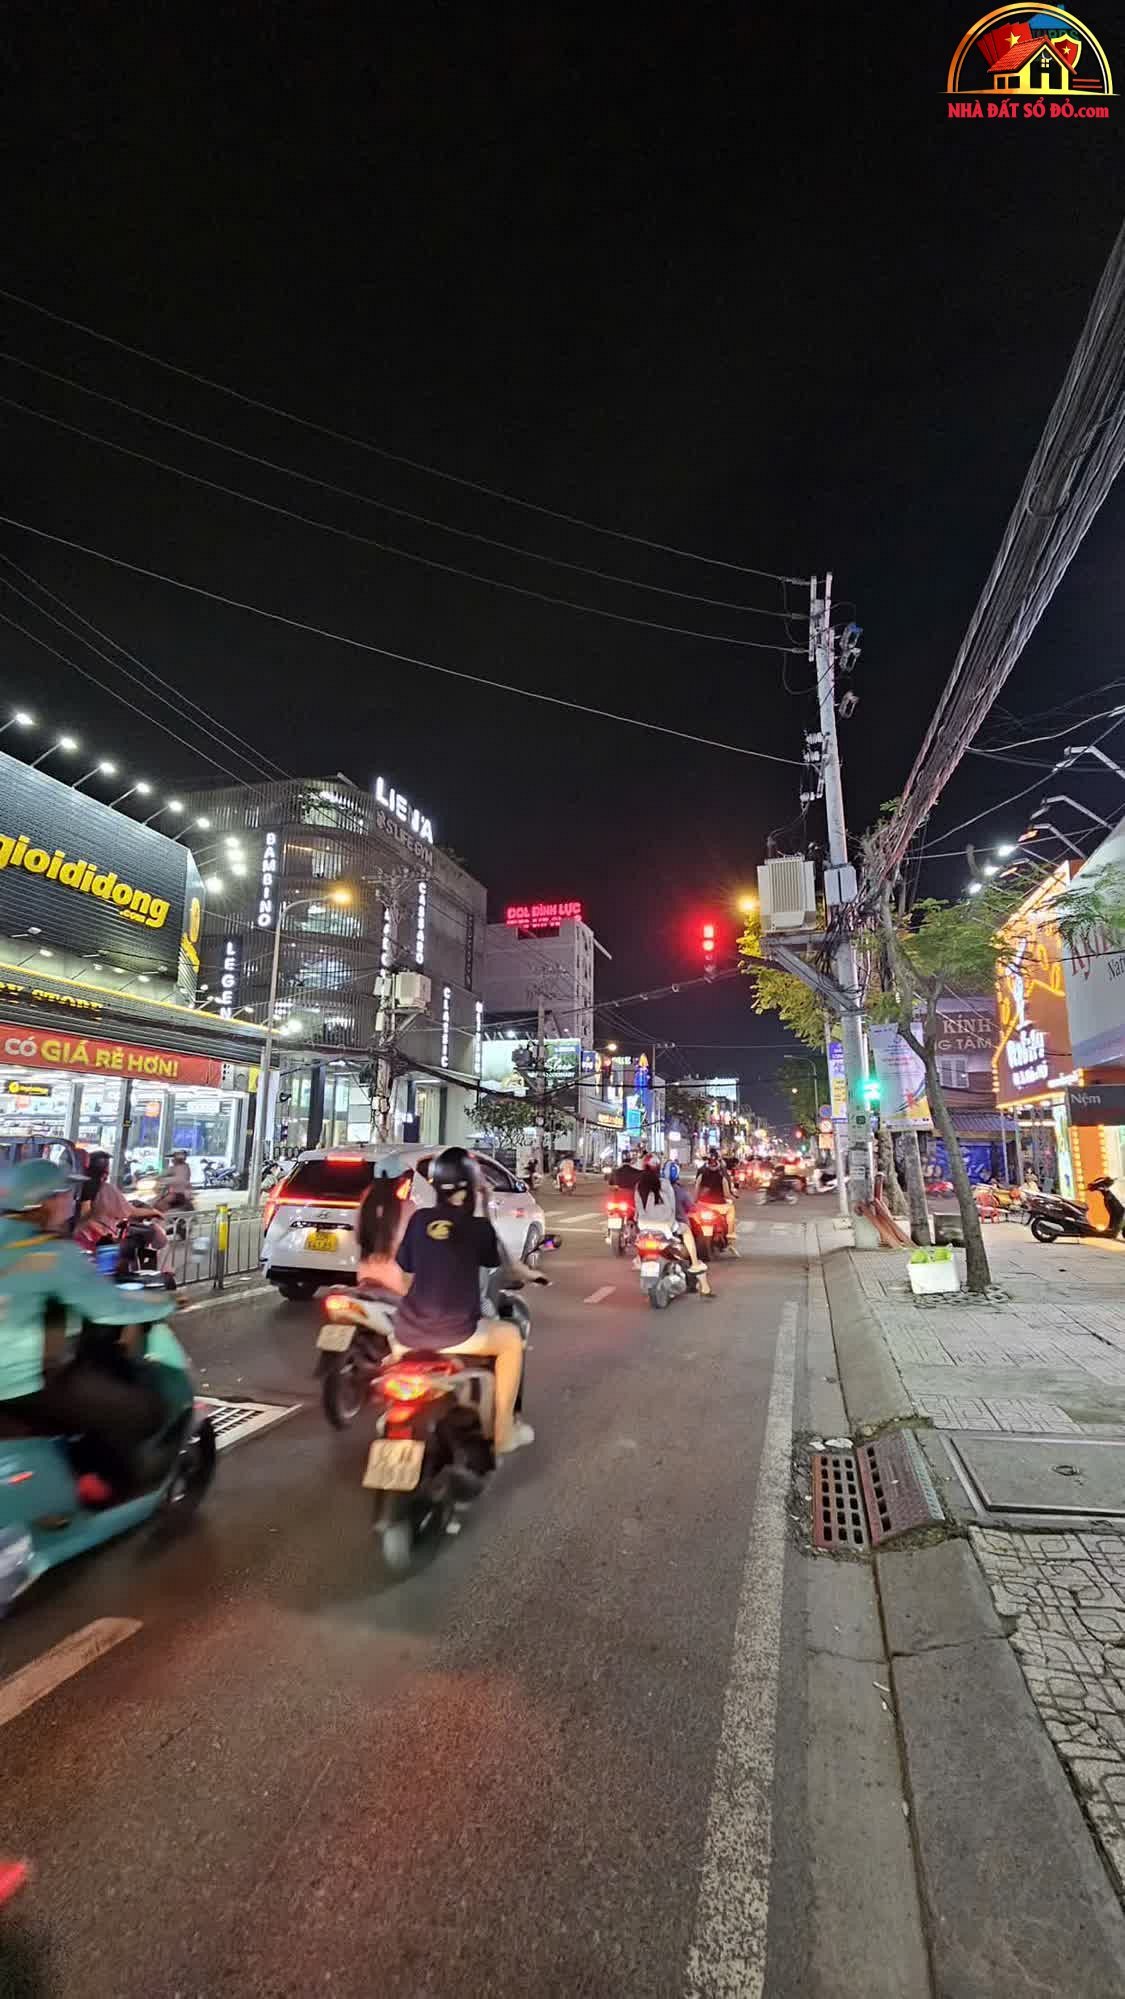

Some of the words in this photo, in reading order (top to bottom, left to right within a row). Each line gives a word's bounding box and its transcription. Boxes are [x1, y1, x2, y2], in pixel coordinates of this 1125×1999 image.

[257, 831, 277, 928] BAMBINO
[558, 902, 582, 916] LỰC
[943, 1014, 993, 1034] KÍNH
[956, 1036, 993, 1050] TÂM
[5, 1036, 37, 1057] CÓ
[40, 1039, 89, 1065] GIÁ
[95, 1048, 125, 1071] RẺ
[127, 1056, 178, 1078] HƠN!
[1071, 1092, 1102, 1107] Nệm
